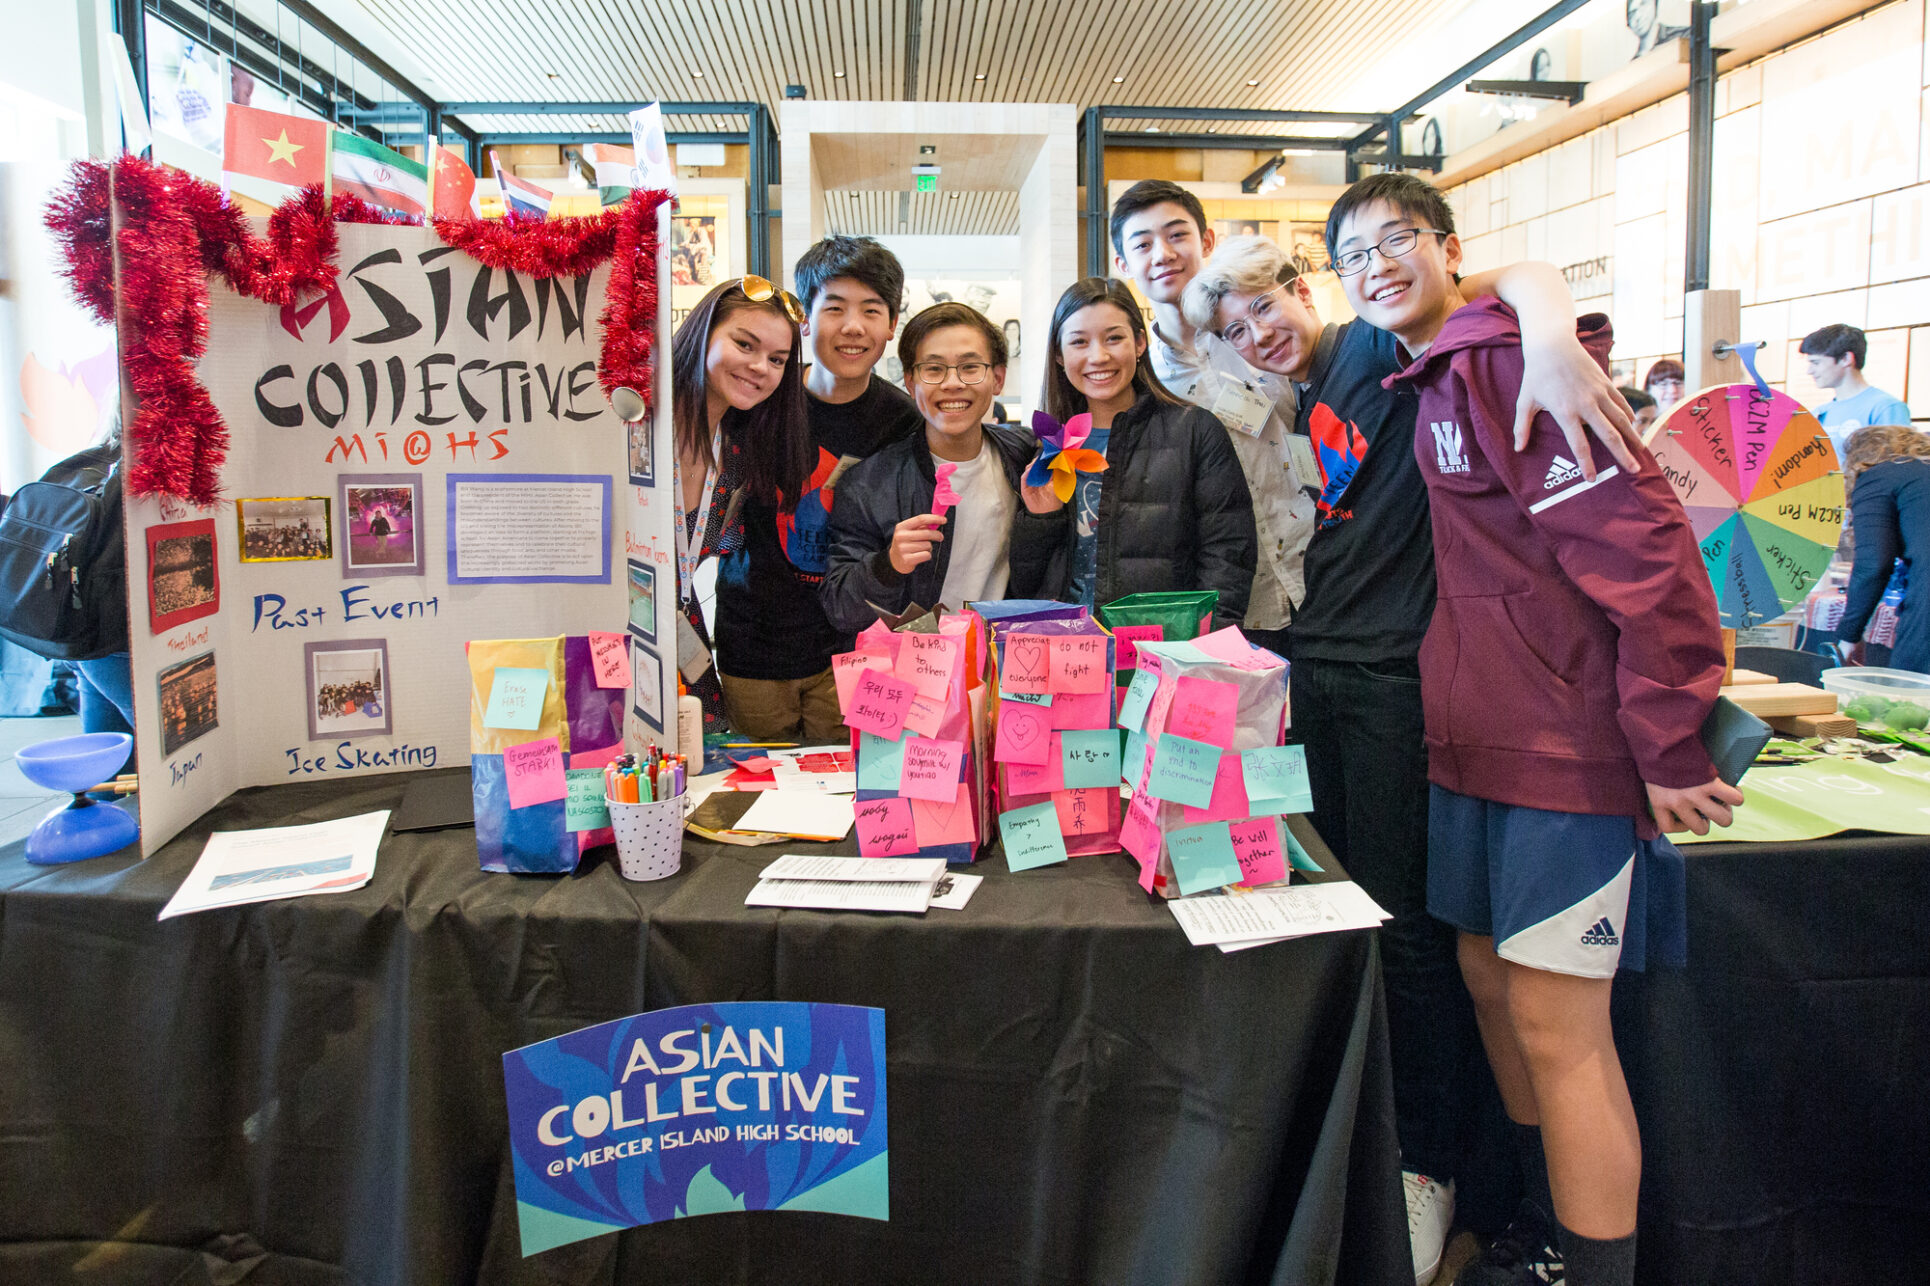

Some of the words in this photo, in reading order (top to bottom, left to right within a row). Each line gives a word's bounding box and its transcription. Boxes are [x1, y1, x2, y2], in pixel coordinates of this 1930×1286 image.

[279, 247, 593, 346] ASIAN
[251, 593, 327, 633] Past
[340, 585, 439, 622] Event
[912, 636, 925, 648] Be
[928, 638, 947, 652] kind
[915, 654, 926, 665] to
[916, 665, 947, 677] others
[1064, 662, 1090, 678] fight
[285, 747, 329, 776] Ice
[334, 741, 438, 770] Skating
[909, 745, 948, 759] Morning
[169, 753, 203, 791] Japan
[1238, 849, 1276, 867] ogether
[1580, 934, 1619, 946] adidas
[620, 1025, 785, 1084] ASIAN
[537, 1071, 865, 1147] COLLECTIVE
[546, 1137, 654, 1178] @MERCER
[660, 1126, 730, 1151] ISLAND
[736, 1124, 779, 1142] HIGH
[784, 1124, 861, 1146] SCHOOL
